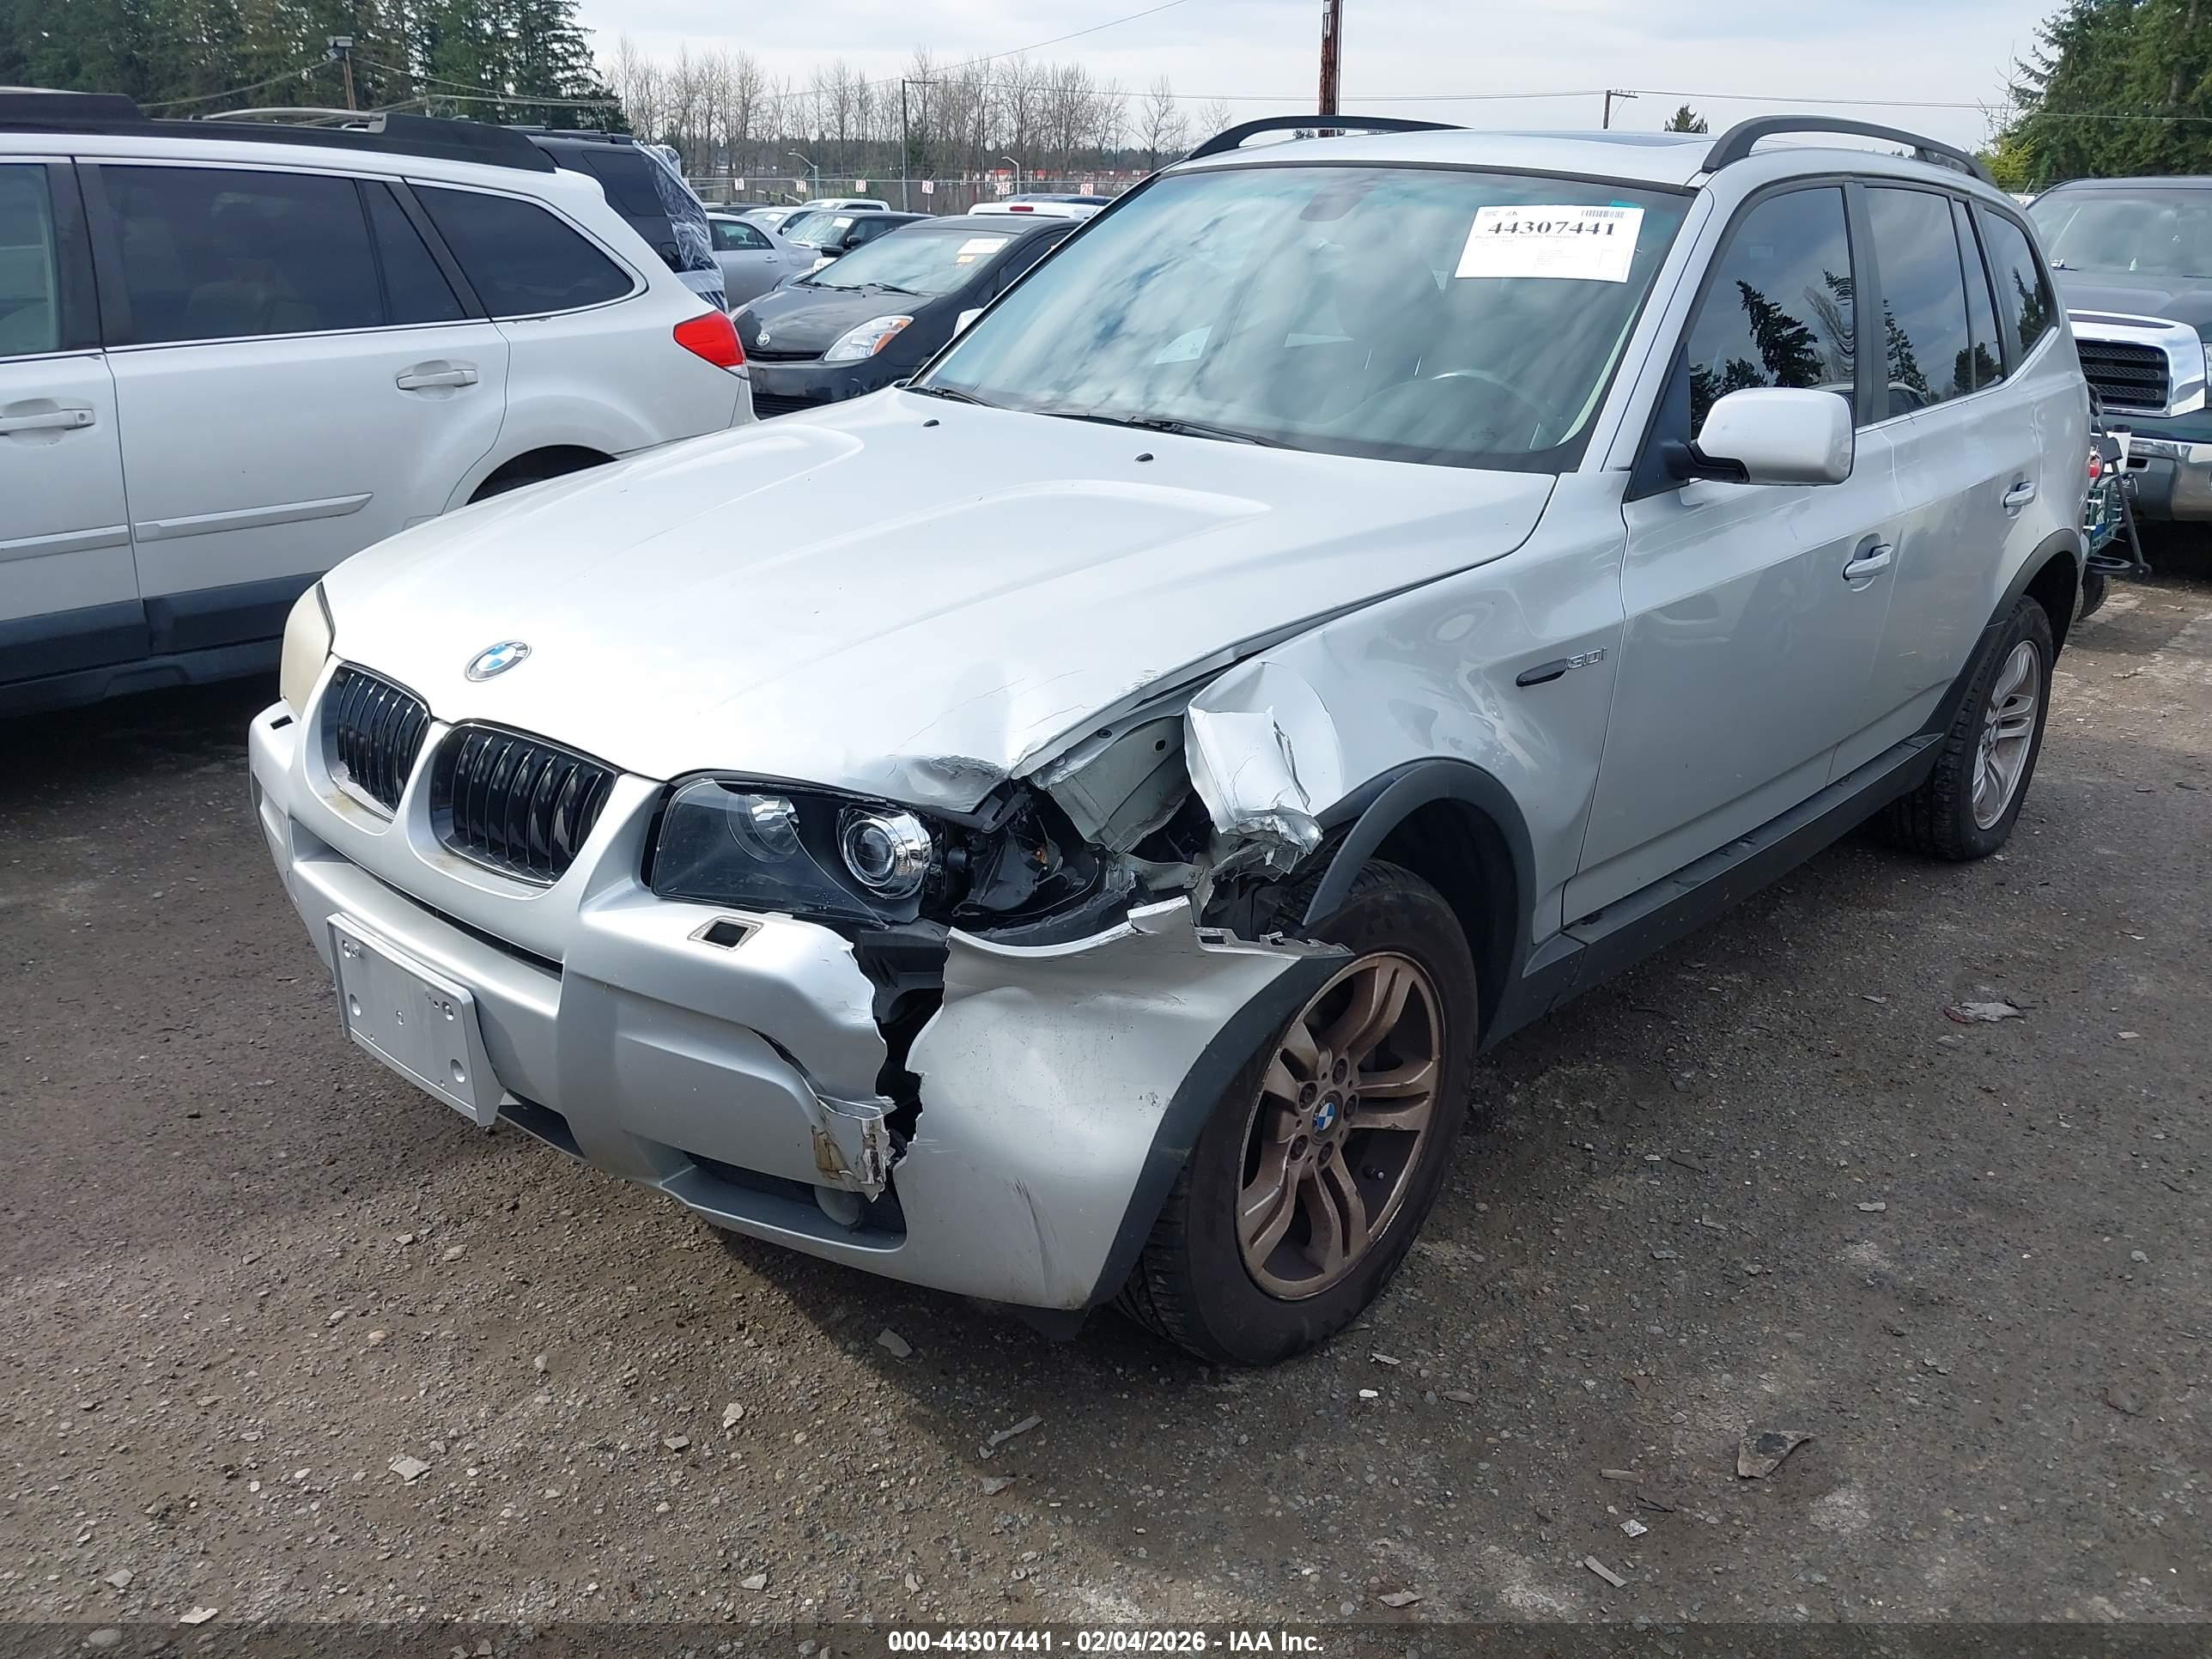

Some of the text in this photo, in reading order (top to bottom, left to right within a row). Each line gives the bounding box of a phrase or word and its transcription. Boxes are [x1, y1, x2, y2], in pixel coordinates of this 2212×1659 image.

[856, 181, 865, 191] 23
[923, 182, 933, 192] 24
[999, 184, 1009, 193] 25
[1082, 184, 1092, 195] 26
[1487, 221, 1614, 235] 44307441
